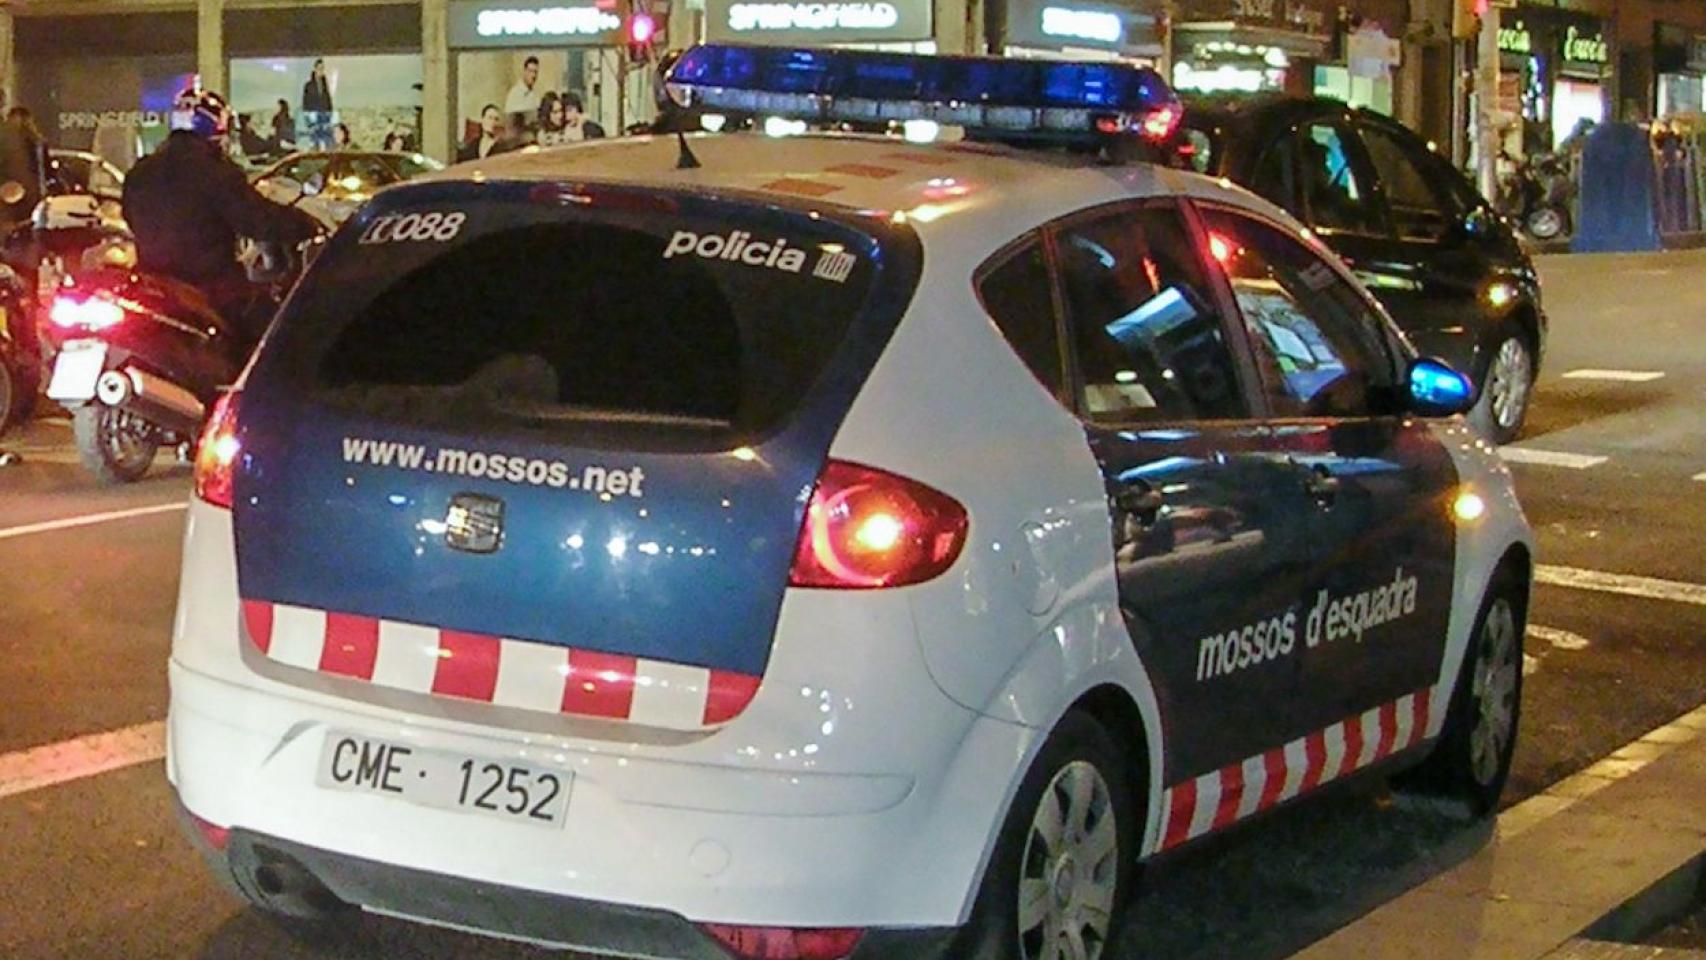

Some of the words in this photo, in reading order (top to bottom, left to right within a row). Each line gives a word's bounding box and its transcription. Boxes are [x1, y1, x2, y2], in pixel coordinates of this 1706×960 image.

[663, 230, 806, 273] policia
[342, 437, 645, 497] www.mossos.net
[1196, 611, 1297, 681] mossos
[1305, 566, 1418, 648] d'esquadra
[457, 758, 561, 821] 1252
